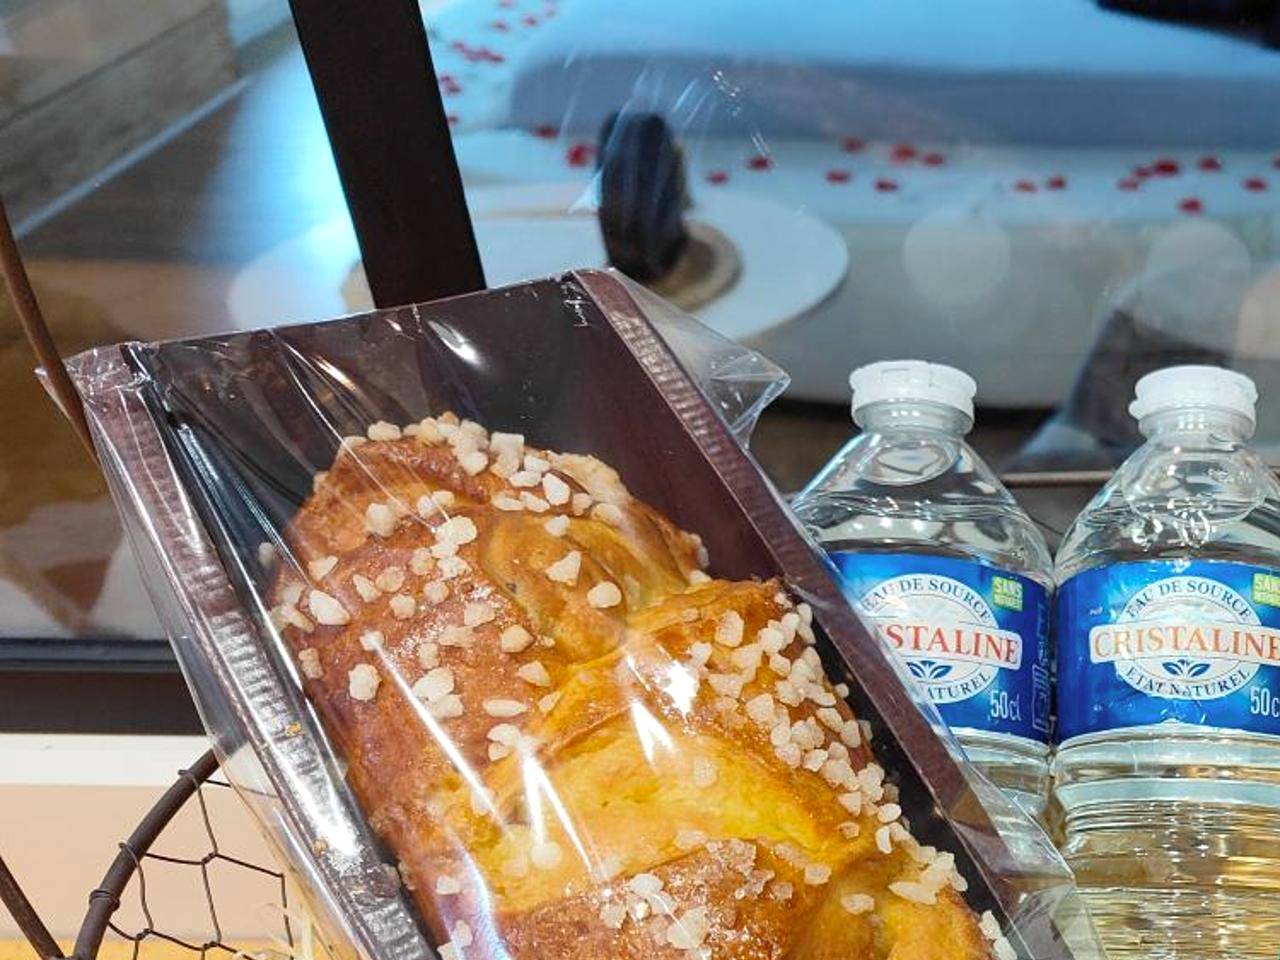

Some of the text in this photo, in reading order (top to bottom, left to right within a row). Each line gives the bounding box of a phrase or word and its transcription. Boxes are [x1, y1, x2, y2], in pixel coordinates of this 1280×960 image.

[900, 577, 924, 592] DE
[929, 579, 991, 624] SOURCE
[1126, 590, 1154, 619] EAU
[1159, 580, 1181, 595] DE
[1186, 579, 1249, 622] SOURCE
[877, 624, 1018, 664] STALINE
[990, 690, 1021, 721] 50cl
